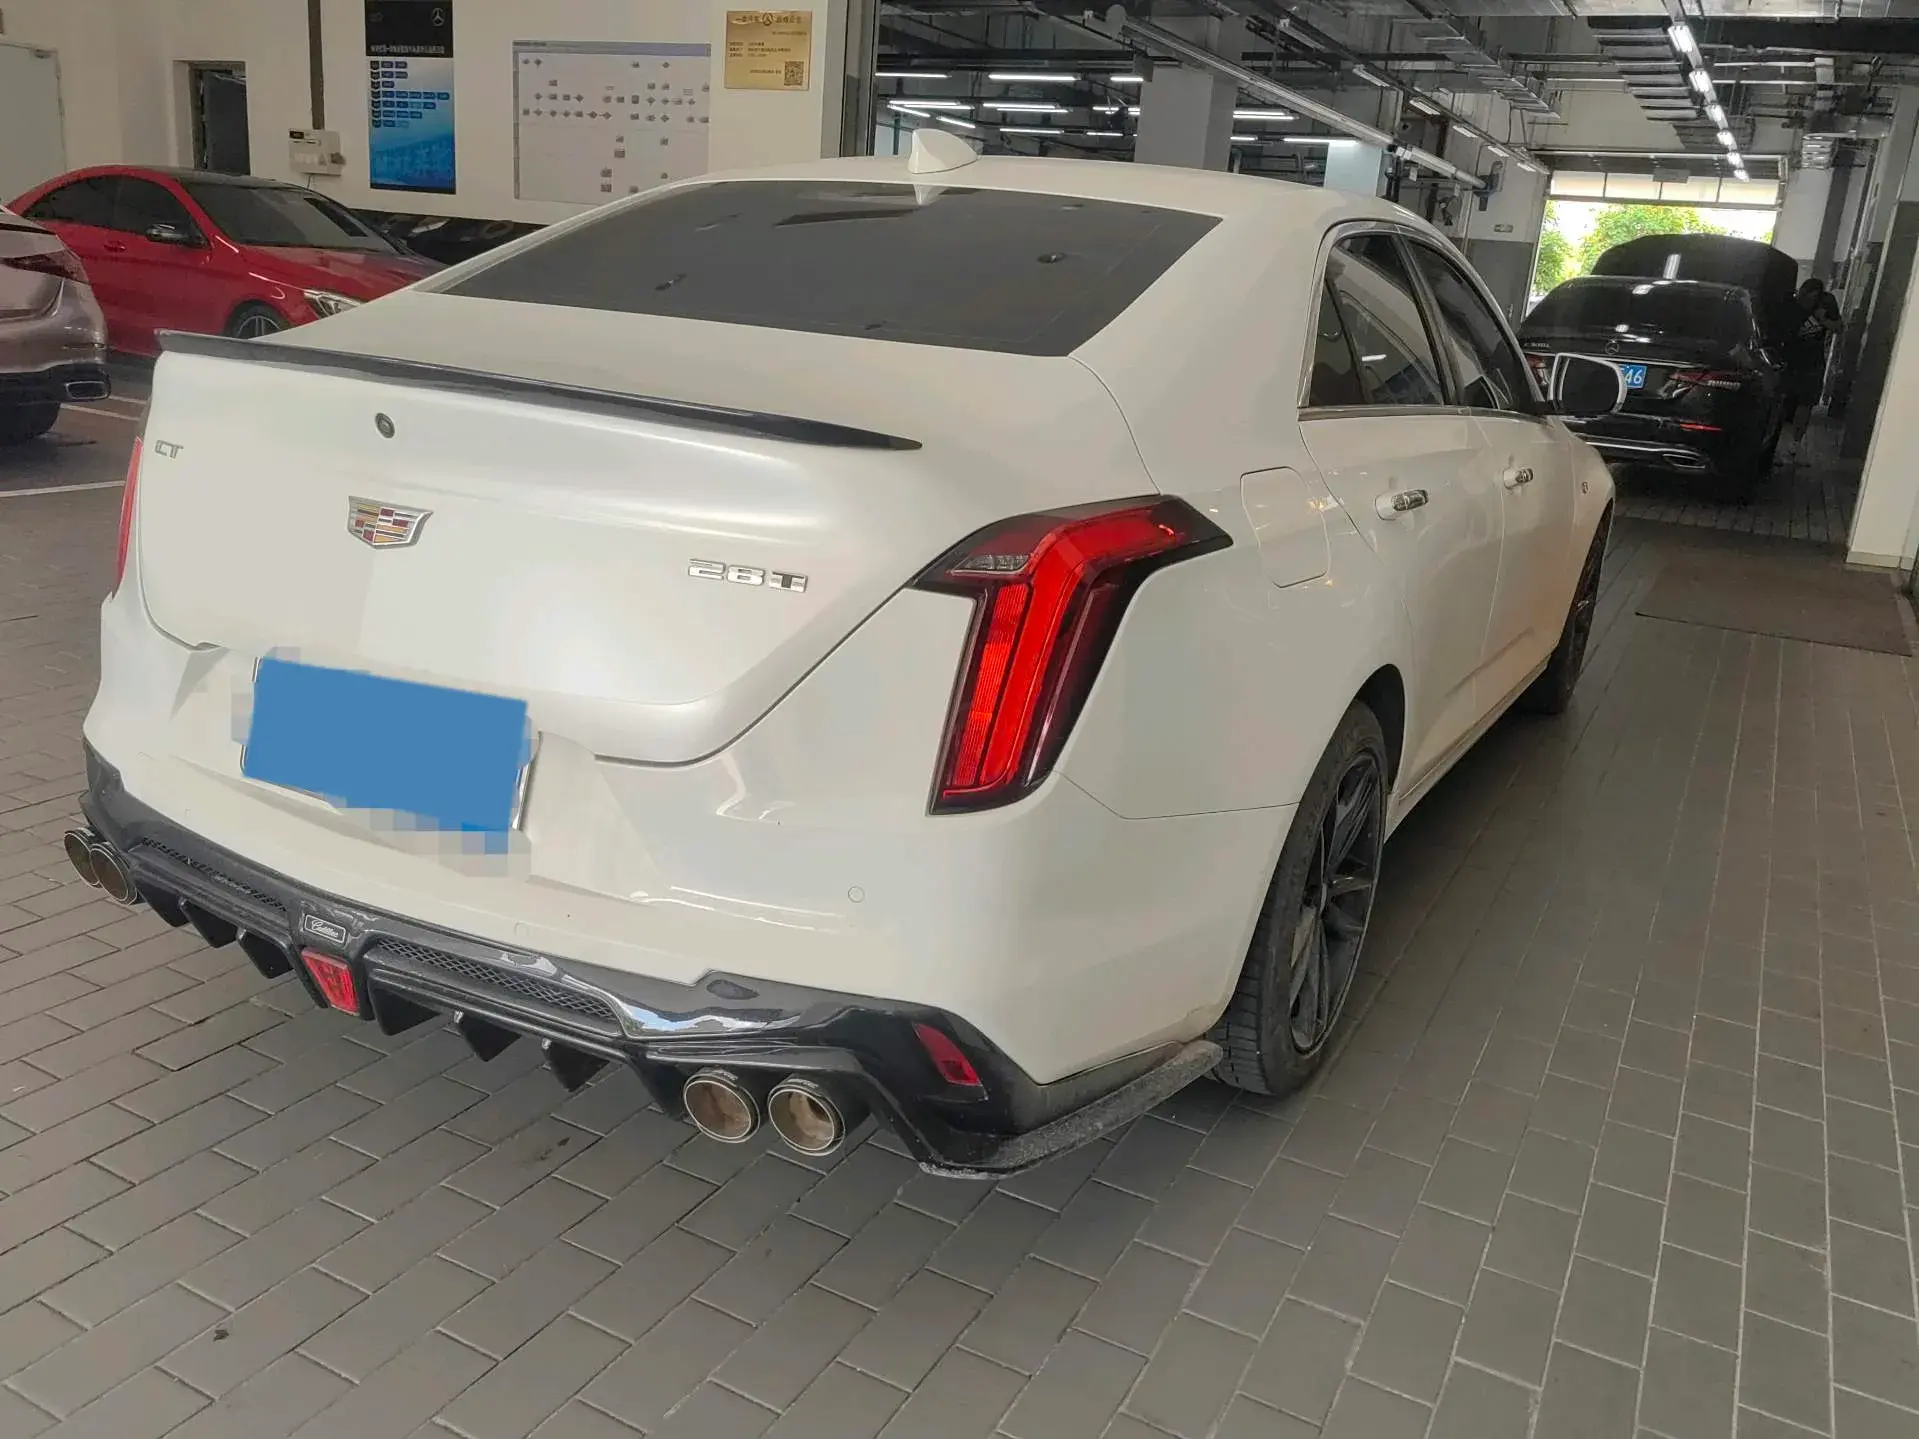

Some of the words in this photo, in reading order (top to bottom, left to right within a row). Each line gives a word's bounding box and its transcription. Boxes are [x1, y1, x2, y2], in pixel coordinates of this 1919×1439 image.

[1620, 367, 1643, 384] 46
[154, 439, 184, 459] CT
[688, 558, 809, 593] 28T
